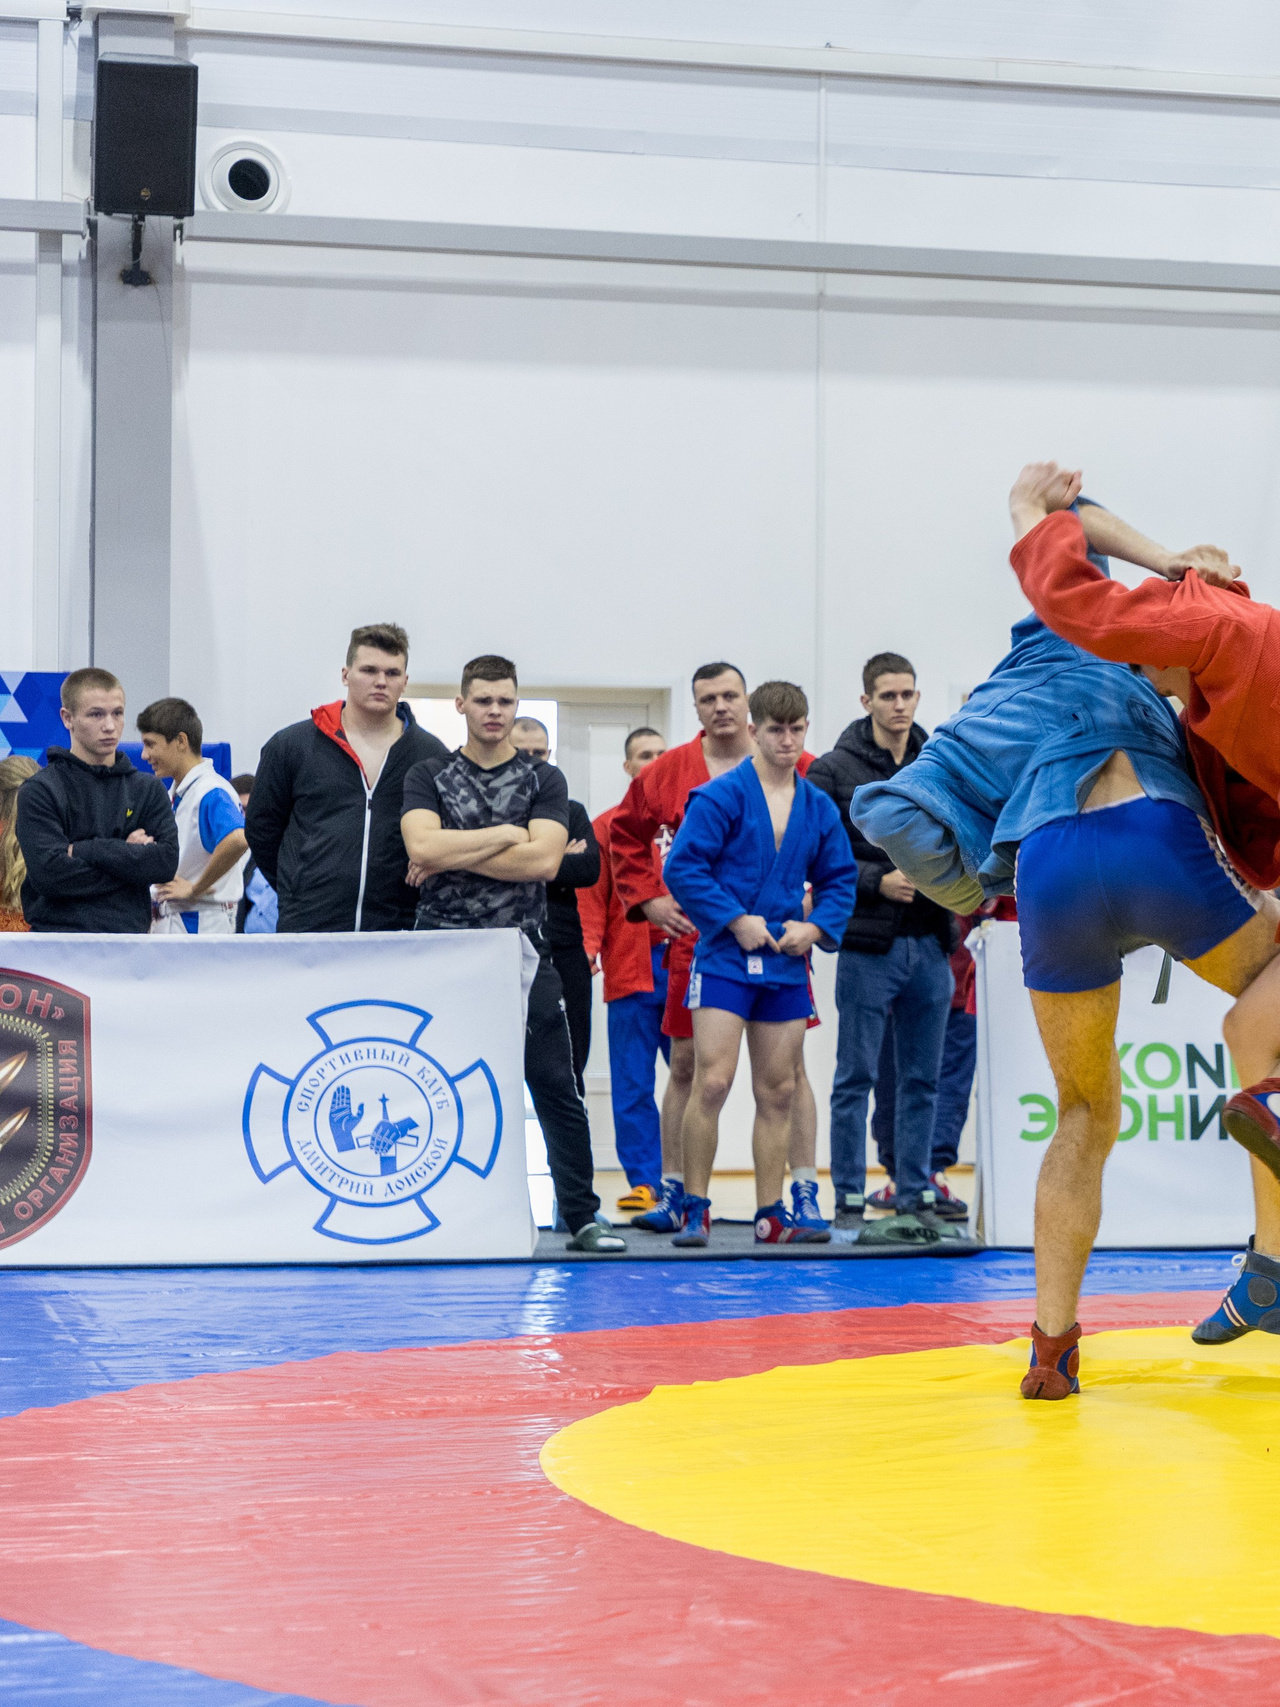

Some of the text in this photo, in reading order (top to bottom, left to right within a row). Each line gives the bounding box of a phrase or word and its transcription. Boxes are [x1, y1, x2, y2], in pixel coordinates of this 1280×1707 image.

[296, 1047, 450, 1112] СПОРТИВНЫЙ КЛУБ
[13, 1040, 82, 1220] ОРГАНИЗАЦИЯ
[1018, 1093, 1228, 1142] ЭОНИ
[296, 1138, 448, 1197] ДМИТРИЙ ДОНСКОЙ
